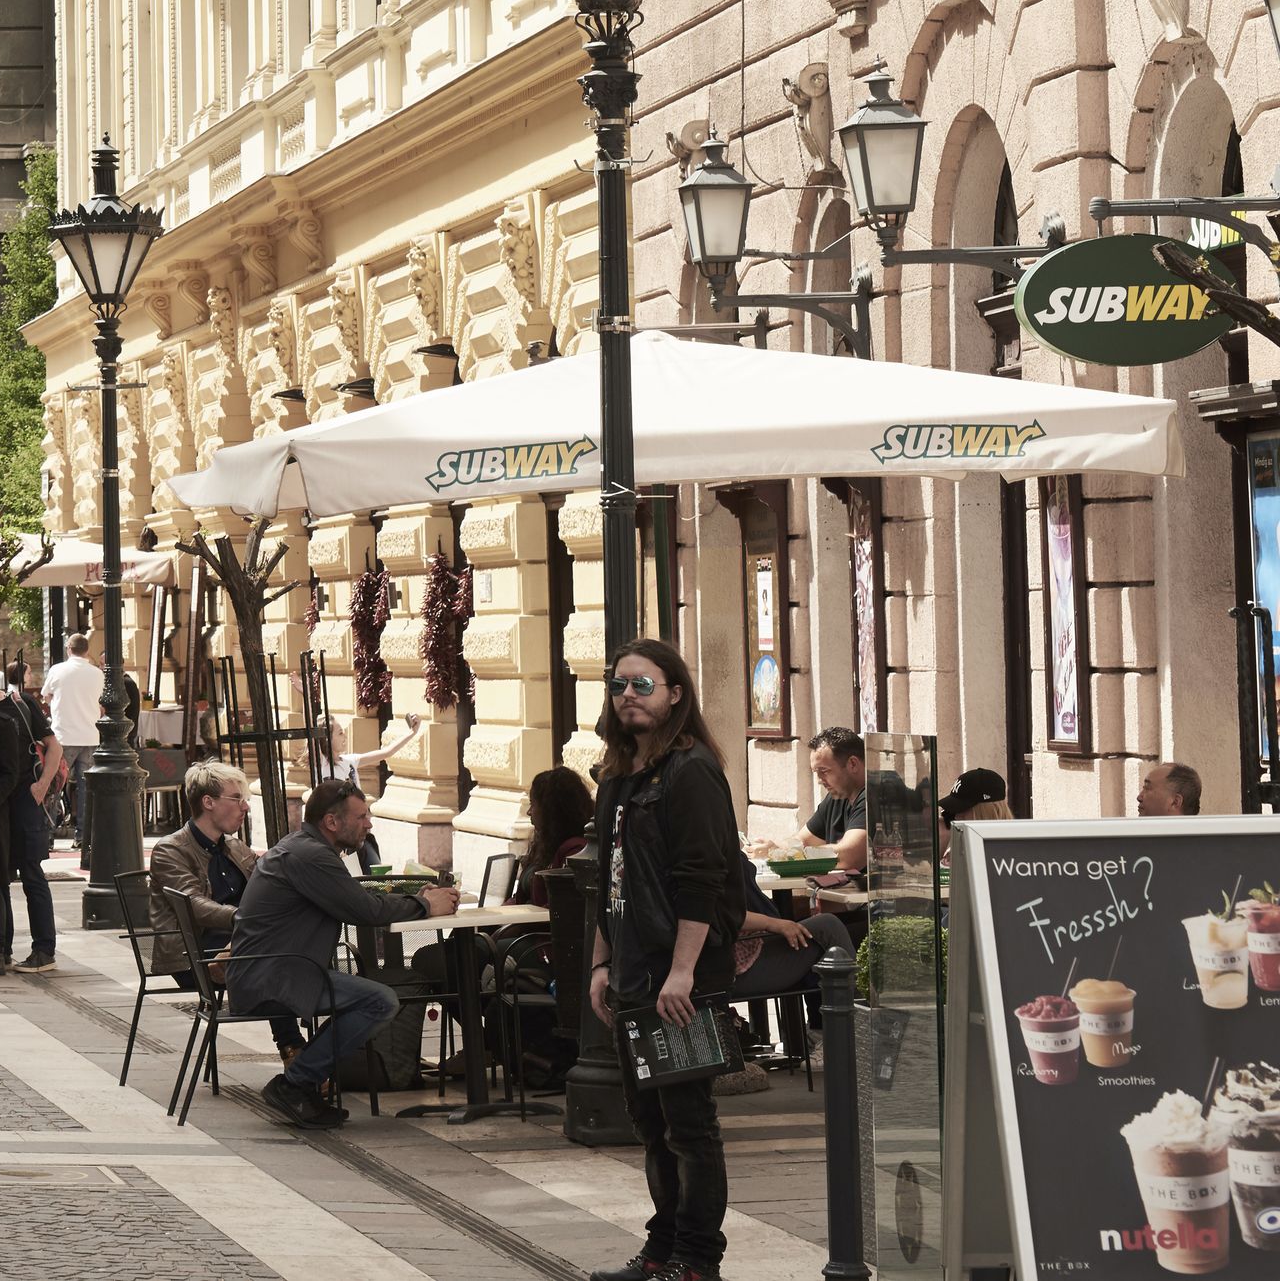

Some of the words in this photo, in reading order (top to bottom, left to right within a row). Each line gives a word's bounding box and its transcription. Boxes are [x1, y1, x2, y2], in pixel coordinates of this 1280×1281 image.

[1033, 283, 1212, 326] SUBWAY
[870, 419, 1046, 465] SUBWAY
[425, 434, 598, 493] SUBWAY
[992, 857, 1079, 877] Wanna
[1086, 856, 1127, 880] get
[1097, 1075, 1156, 1087] Smoothies
[1149, 1186, 1177, 1200] THE
[1099, 1222, 1220, 1251] nutella
[1040, 1262, 1061, 1270] THE
[1067, 1262, 1090, 1270] BOX
